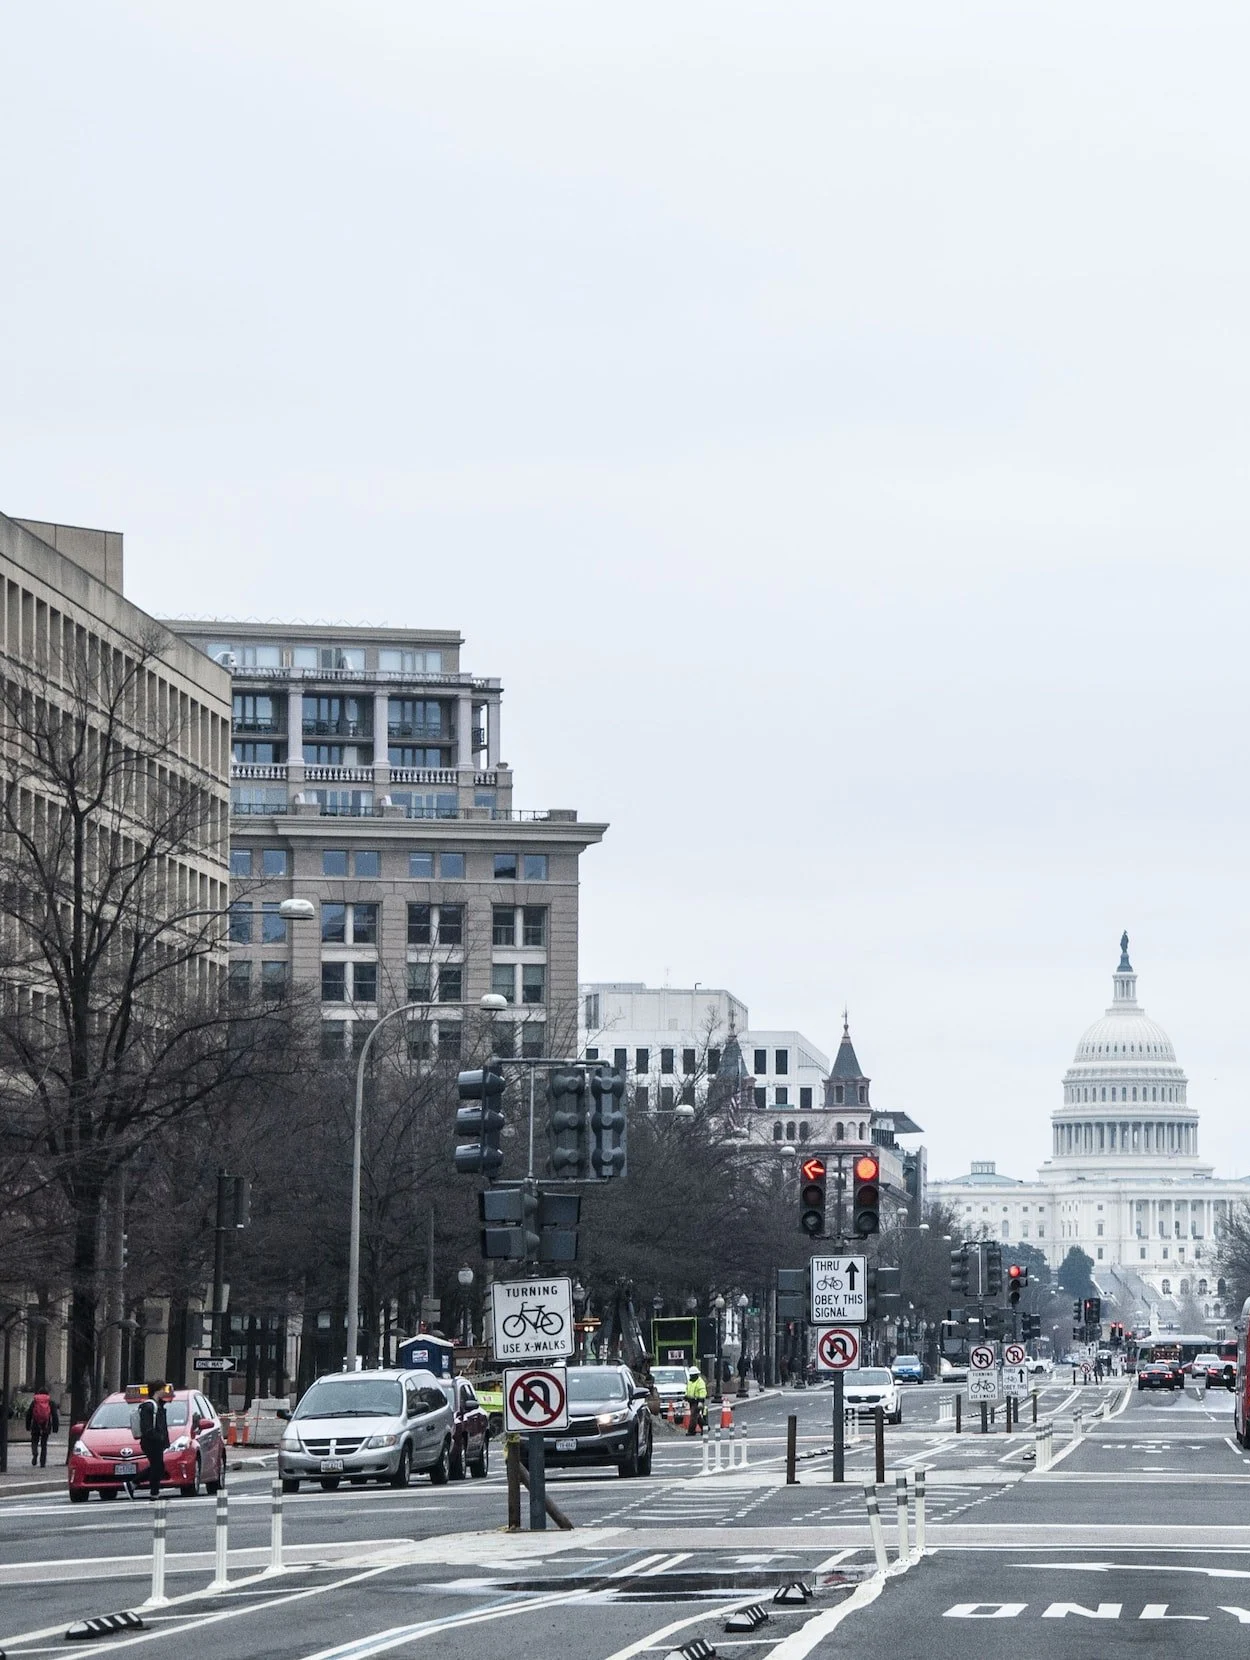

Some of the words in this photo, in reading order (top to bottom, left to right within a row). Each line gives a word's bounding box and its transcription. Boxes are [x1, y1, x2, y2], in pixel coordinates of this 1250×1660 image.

[815, 1260, 840, 1271] THRU
[505, 1285, 558, 1298] TURNING
[815, 1294, 840, 1306] OBEY
[843, 1294, 863, 1305] THIS
[815, 1307, 848, 1318] SIGNAL
[503, 1343, 521, 1354] USE
[524, 1340, 566, 1352] X-WALKS
